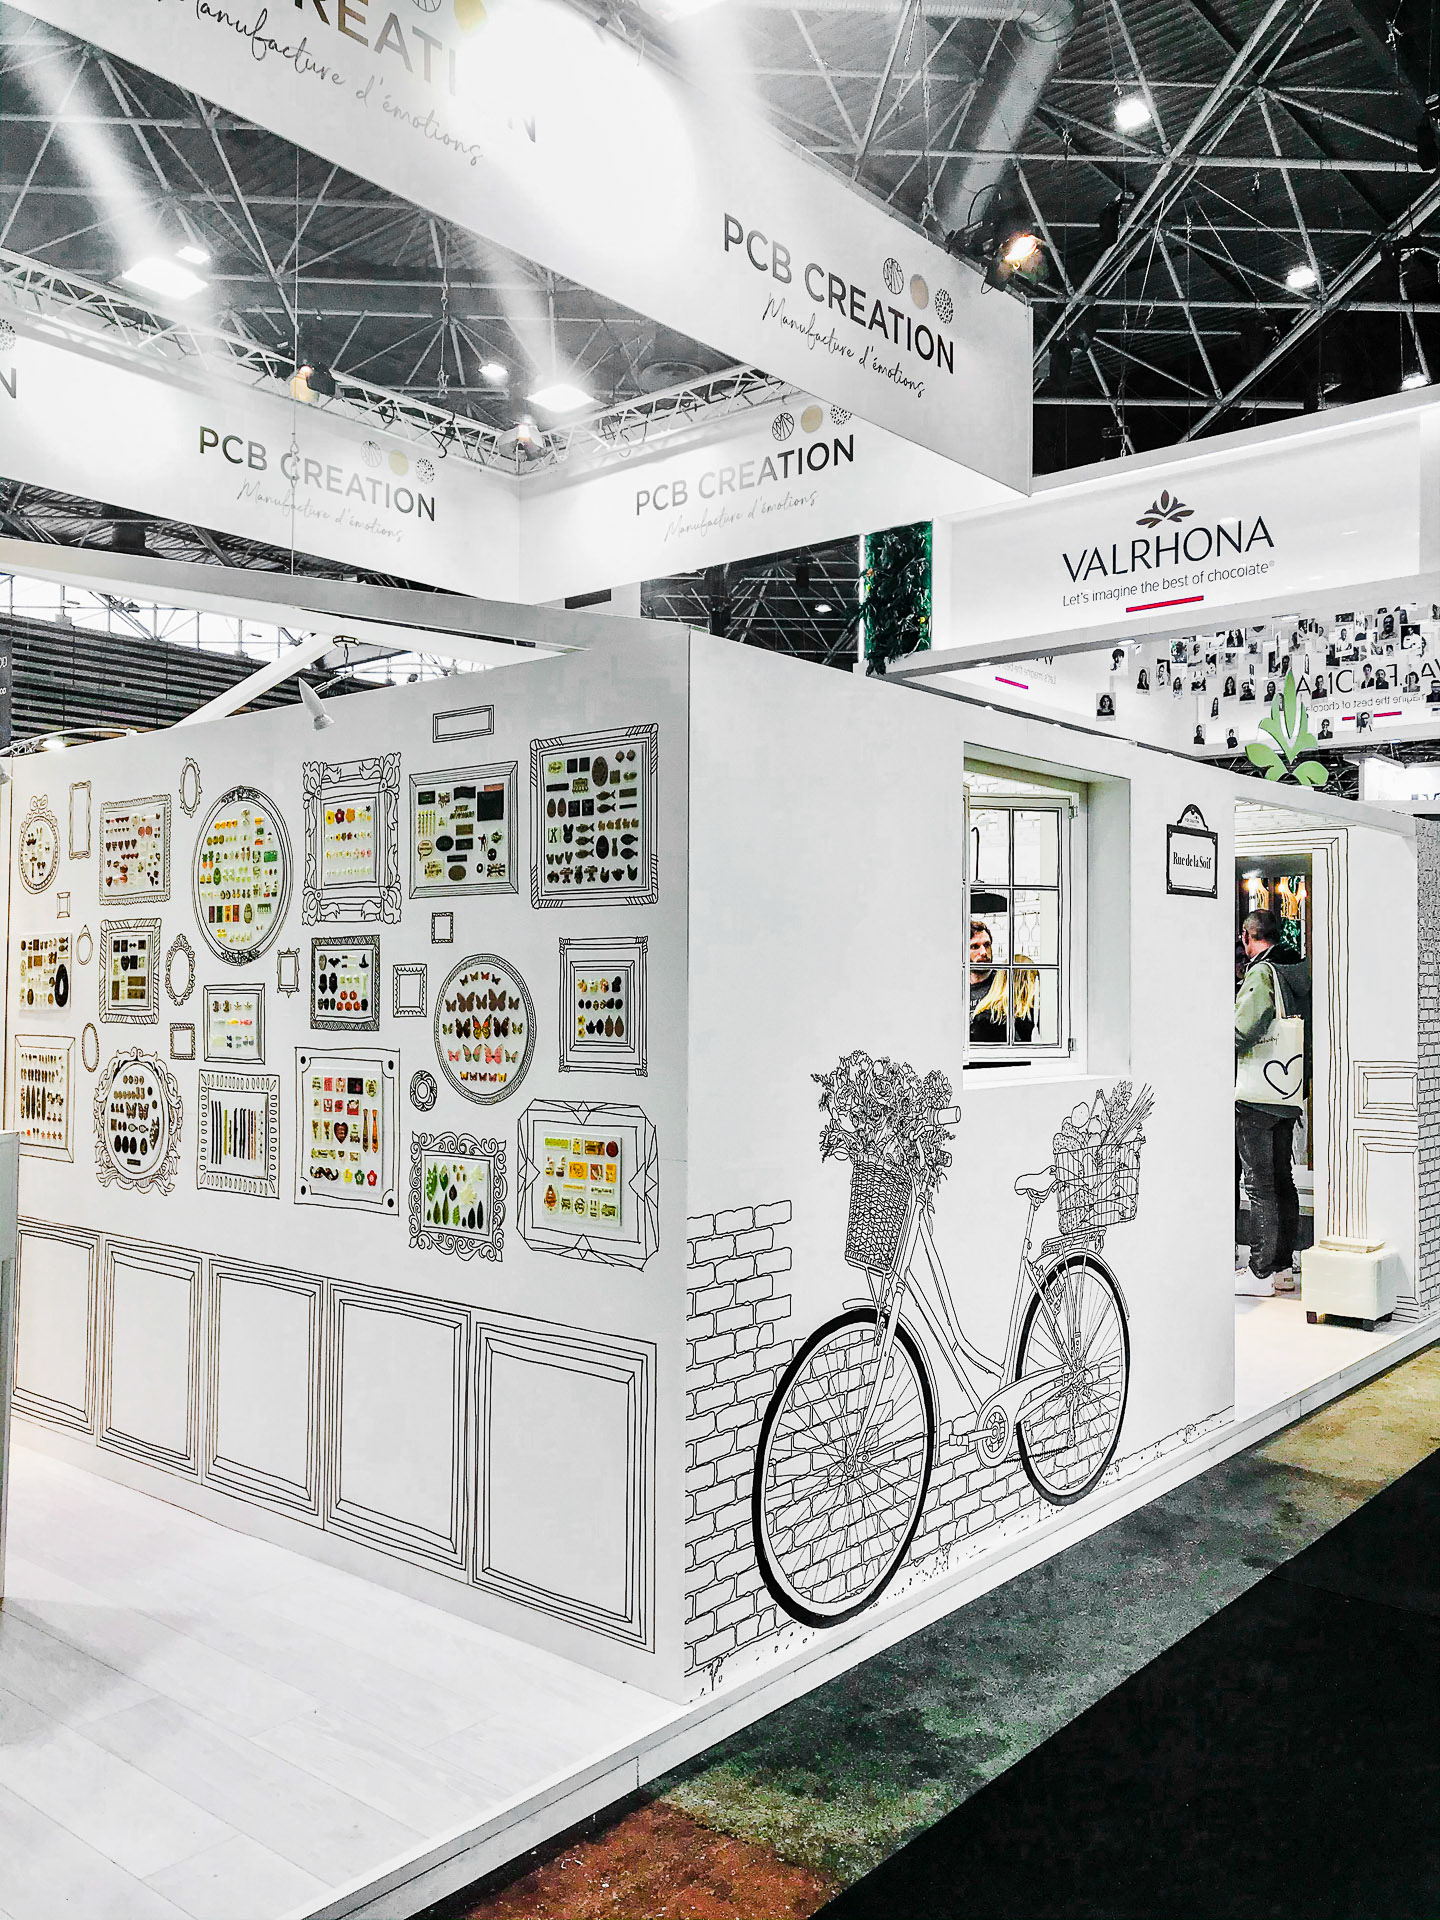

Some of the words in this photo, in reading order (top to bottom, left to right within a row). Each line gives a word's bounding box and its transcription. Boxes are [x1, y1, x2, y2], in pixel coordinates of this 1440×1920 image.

[158, 0, 346, 85] anufacture
[724, 212, 792, 284] PCB
[804, 263, 954, 375] CREATION
[762, 293, 855, 358] Manufacture
[859, 346, 926, 398] d'émotions
[200, 426, 267, 471] PCB
[281, 452, 436, 522] CREATION
[237, 478, 330, 519] Manufacture
[636, 480, 688, 516] PCB
[698, 434, 854, 498] CREATION
[664, 506, 742, 542] Manufacture
[1062, 516, 1275, 583] VALRHONA
[1063, 592, 1090, 607] Let's
[1092, 585, 1138, 601] imagine
[1140, 580, 1160, 594] the
[1162, 574, 1188, 590] best
[1192, 570, 1204, 584] of
[1173, 851, 1186, 866] Rue
[1185, 853, 1193, 867] de
[1193, 854, 1199, 868] la
